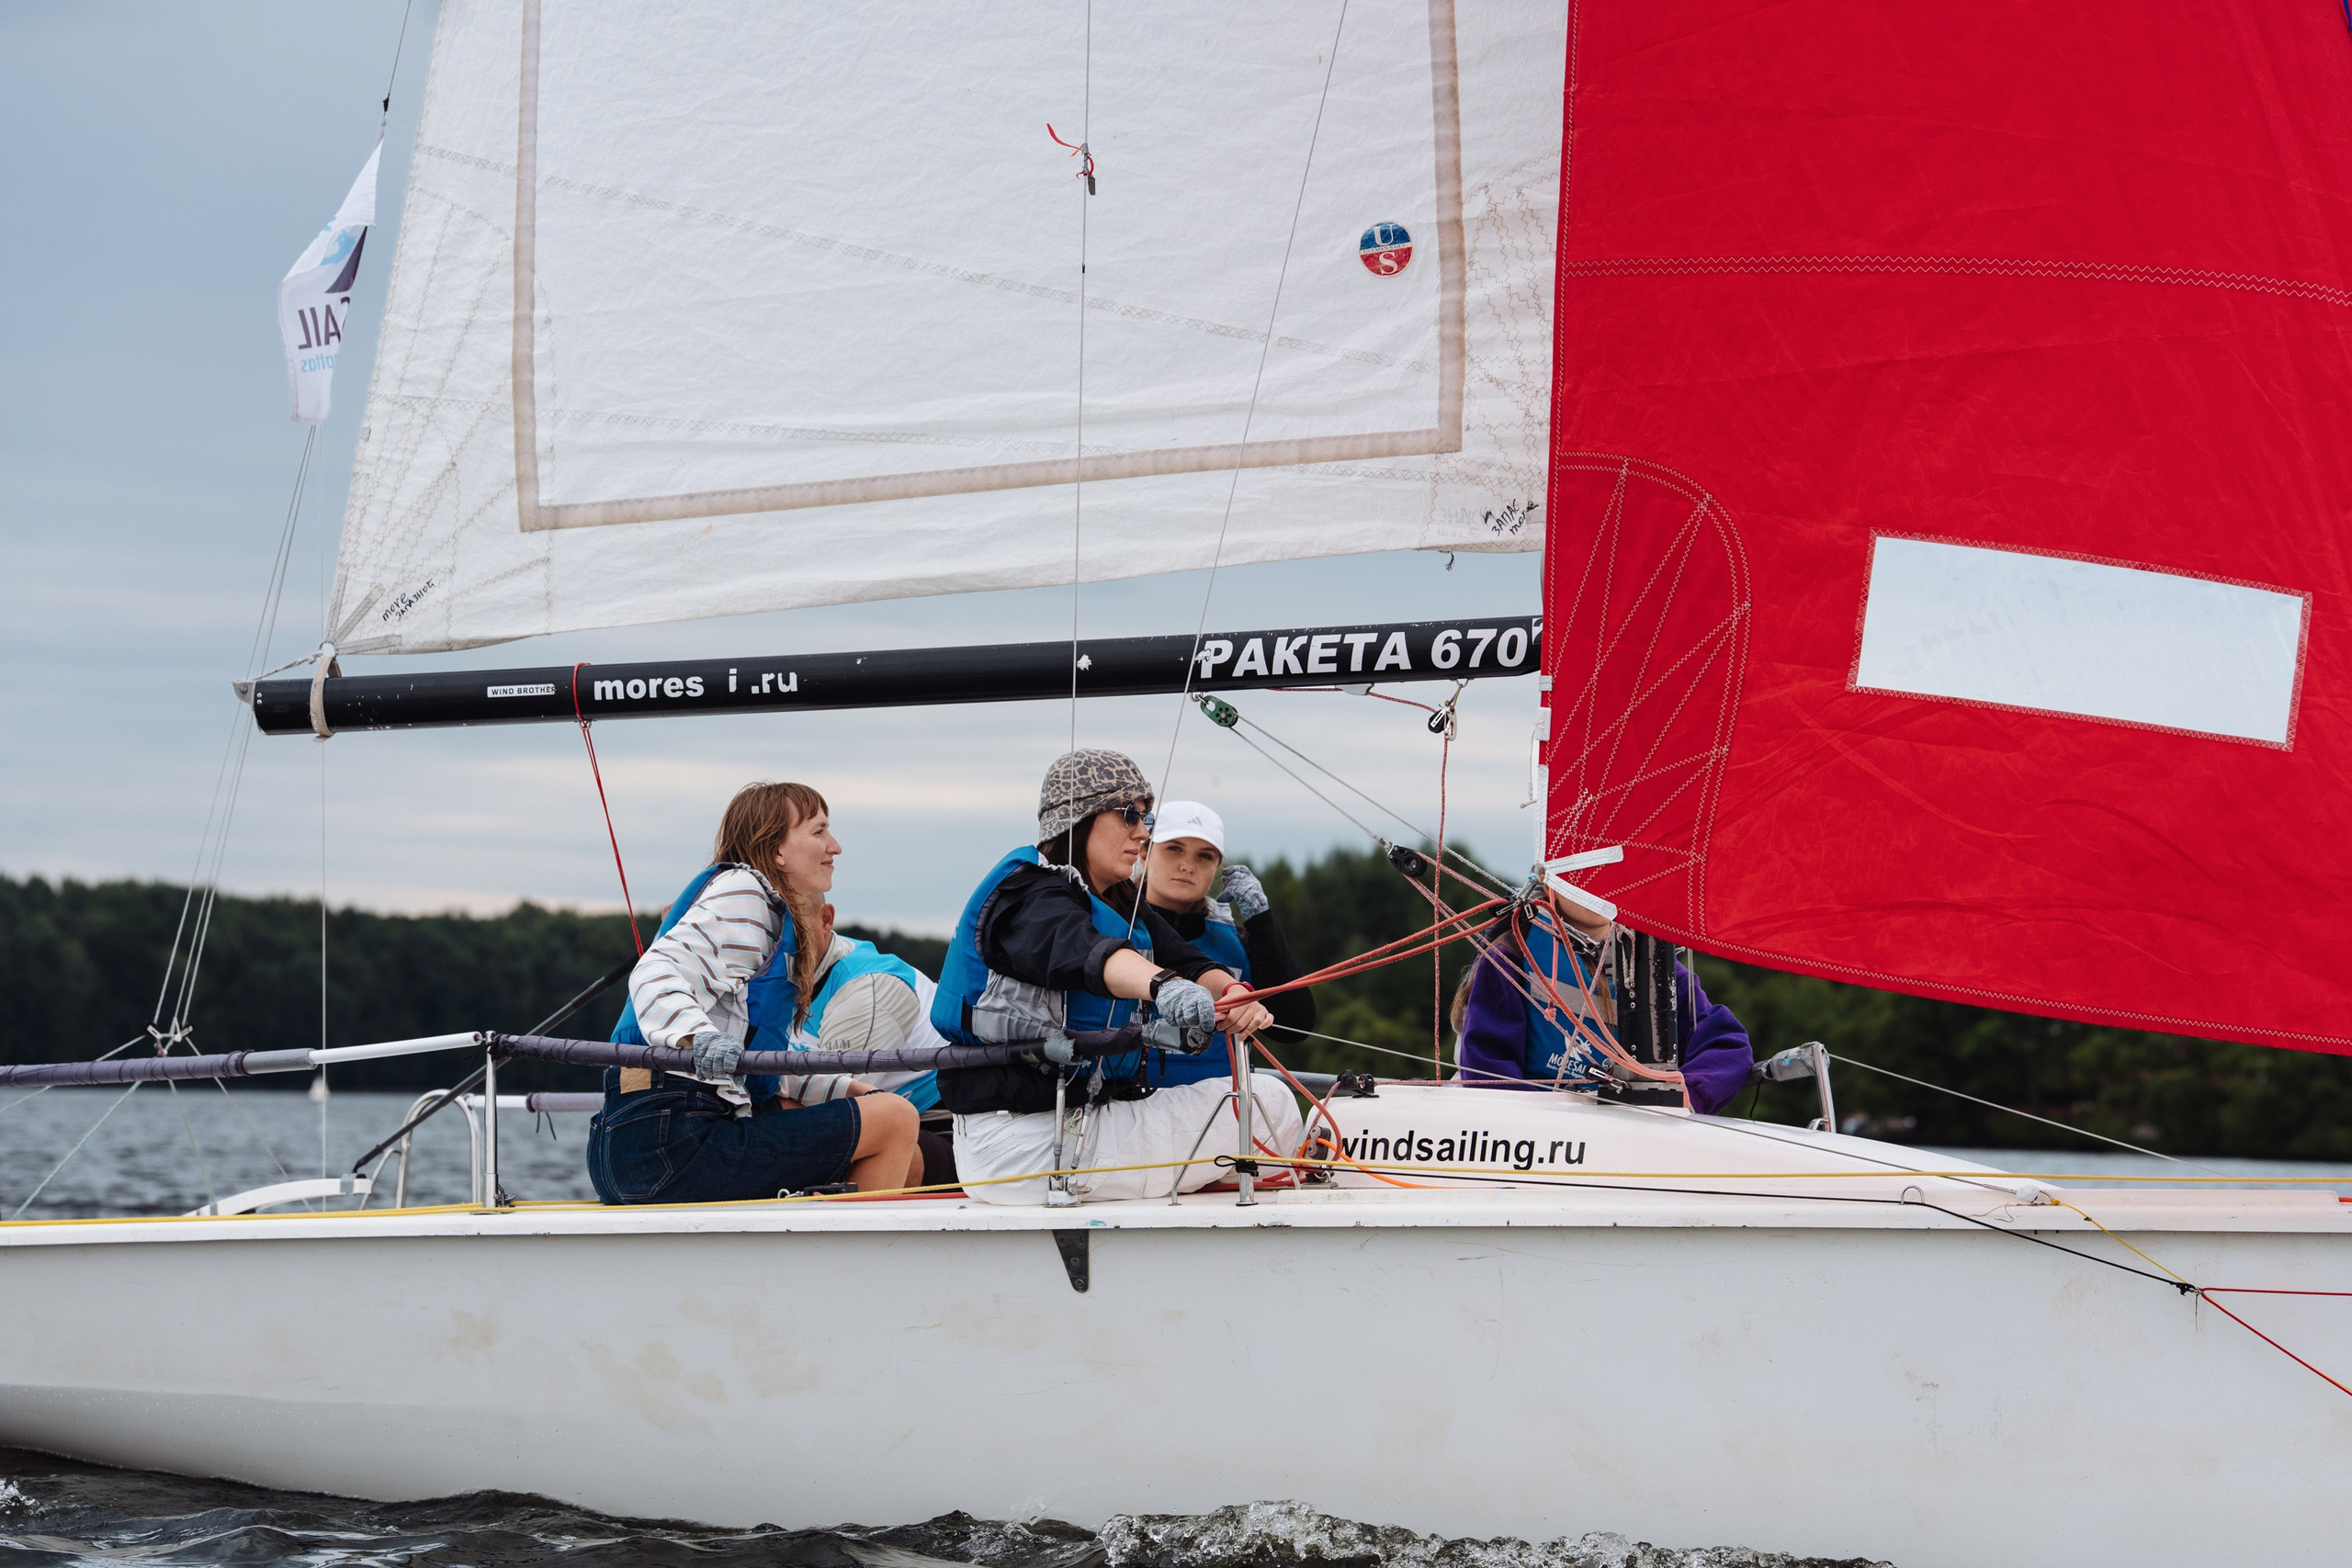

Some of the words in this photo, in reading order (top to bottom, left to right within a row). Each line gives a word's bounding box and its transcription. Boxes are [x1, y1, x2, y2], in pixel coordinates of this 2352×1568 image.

[1374, 223, 1395, 246] U
[1379, 251, 1398, 275] S
[1430, 626, 1528, 670] 670
[1548, 1053, 1587, 1074] MOESAI
